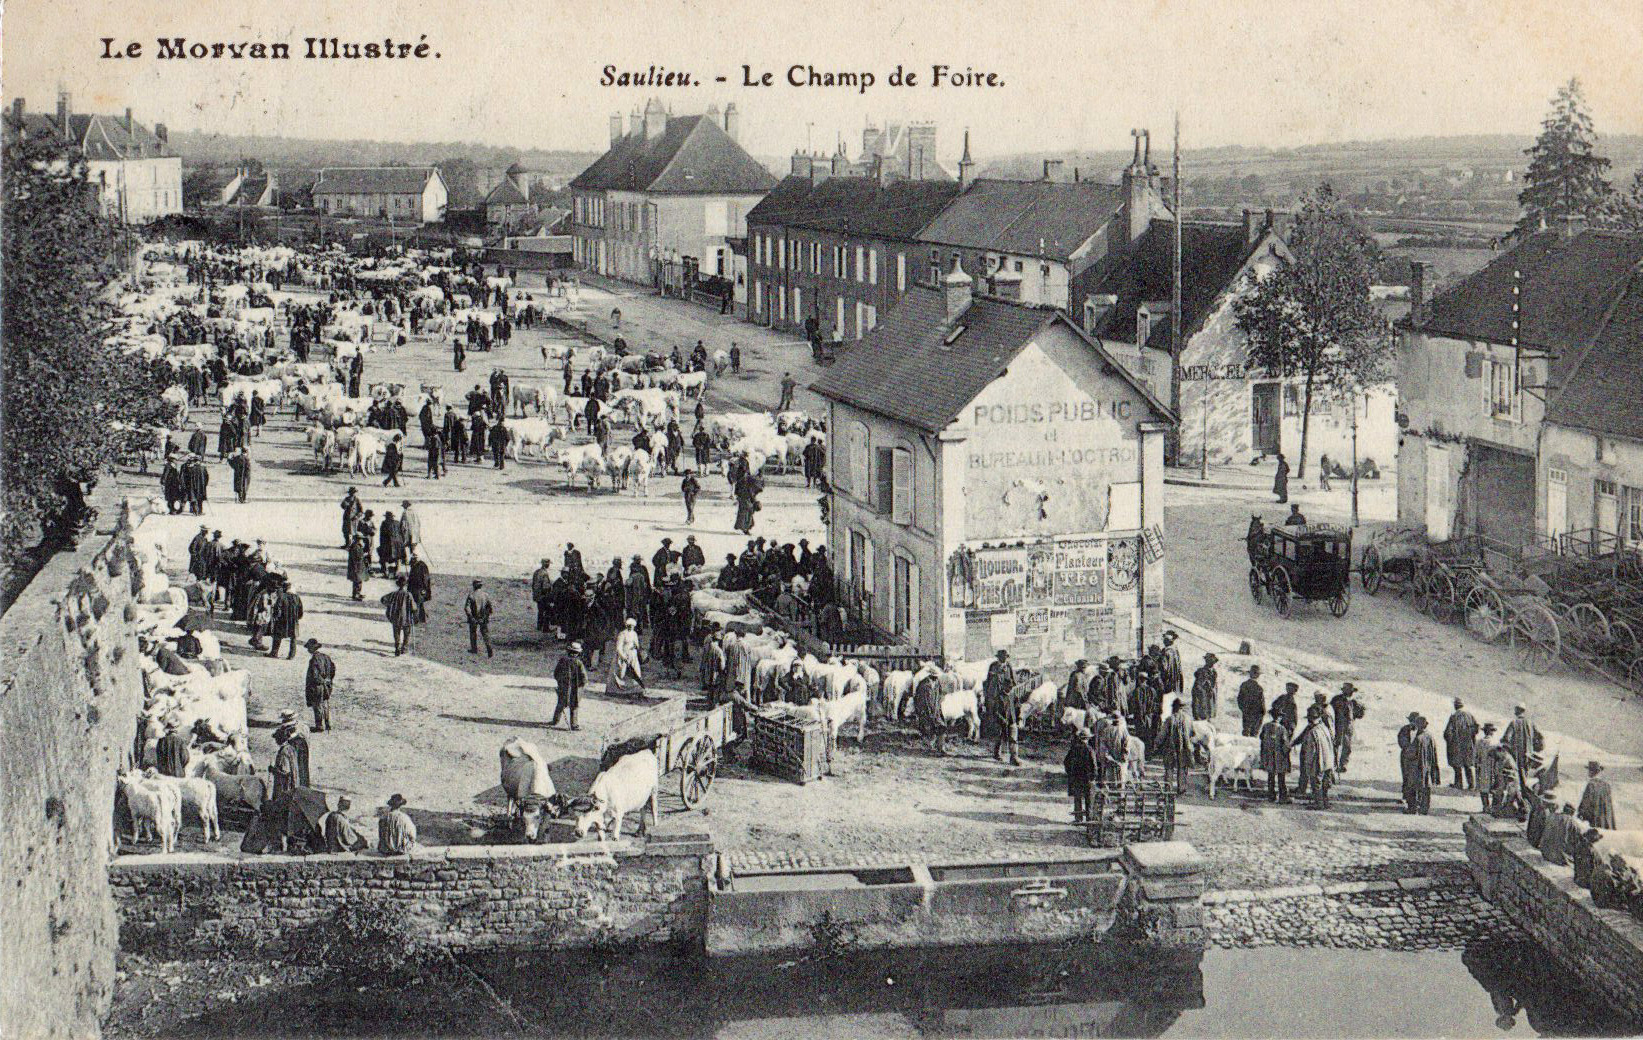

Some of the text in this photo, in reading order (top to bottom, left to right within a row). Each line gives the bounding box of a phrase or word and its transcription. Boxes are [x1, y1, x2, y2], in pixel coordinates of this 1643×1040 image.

[974, 400, 1132, 425] POIDS PUBLIC
[969, 450, 1040, 469] BUREAU
[1055, 552, 1104, 570] Planteur
[1060, 570, 1099, 588] Thé
